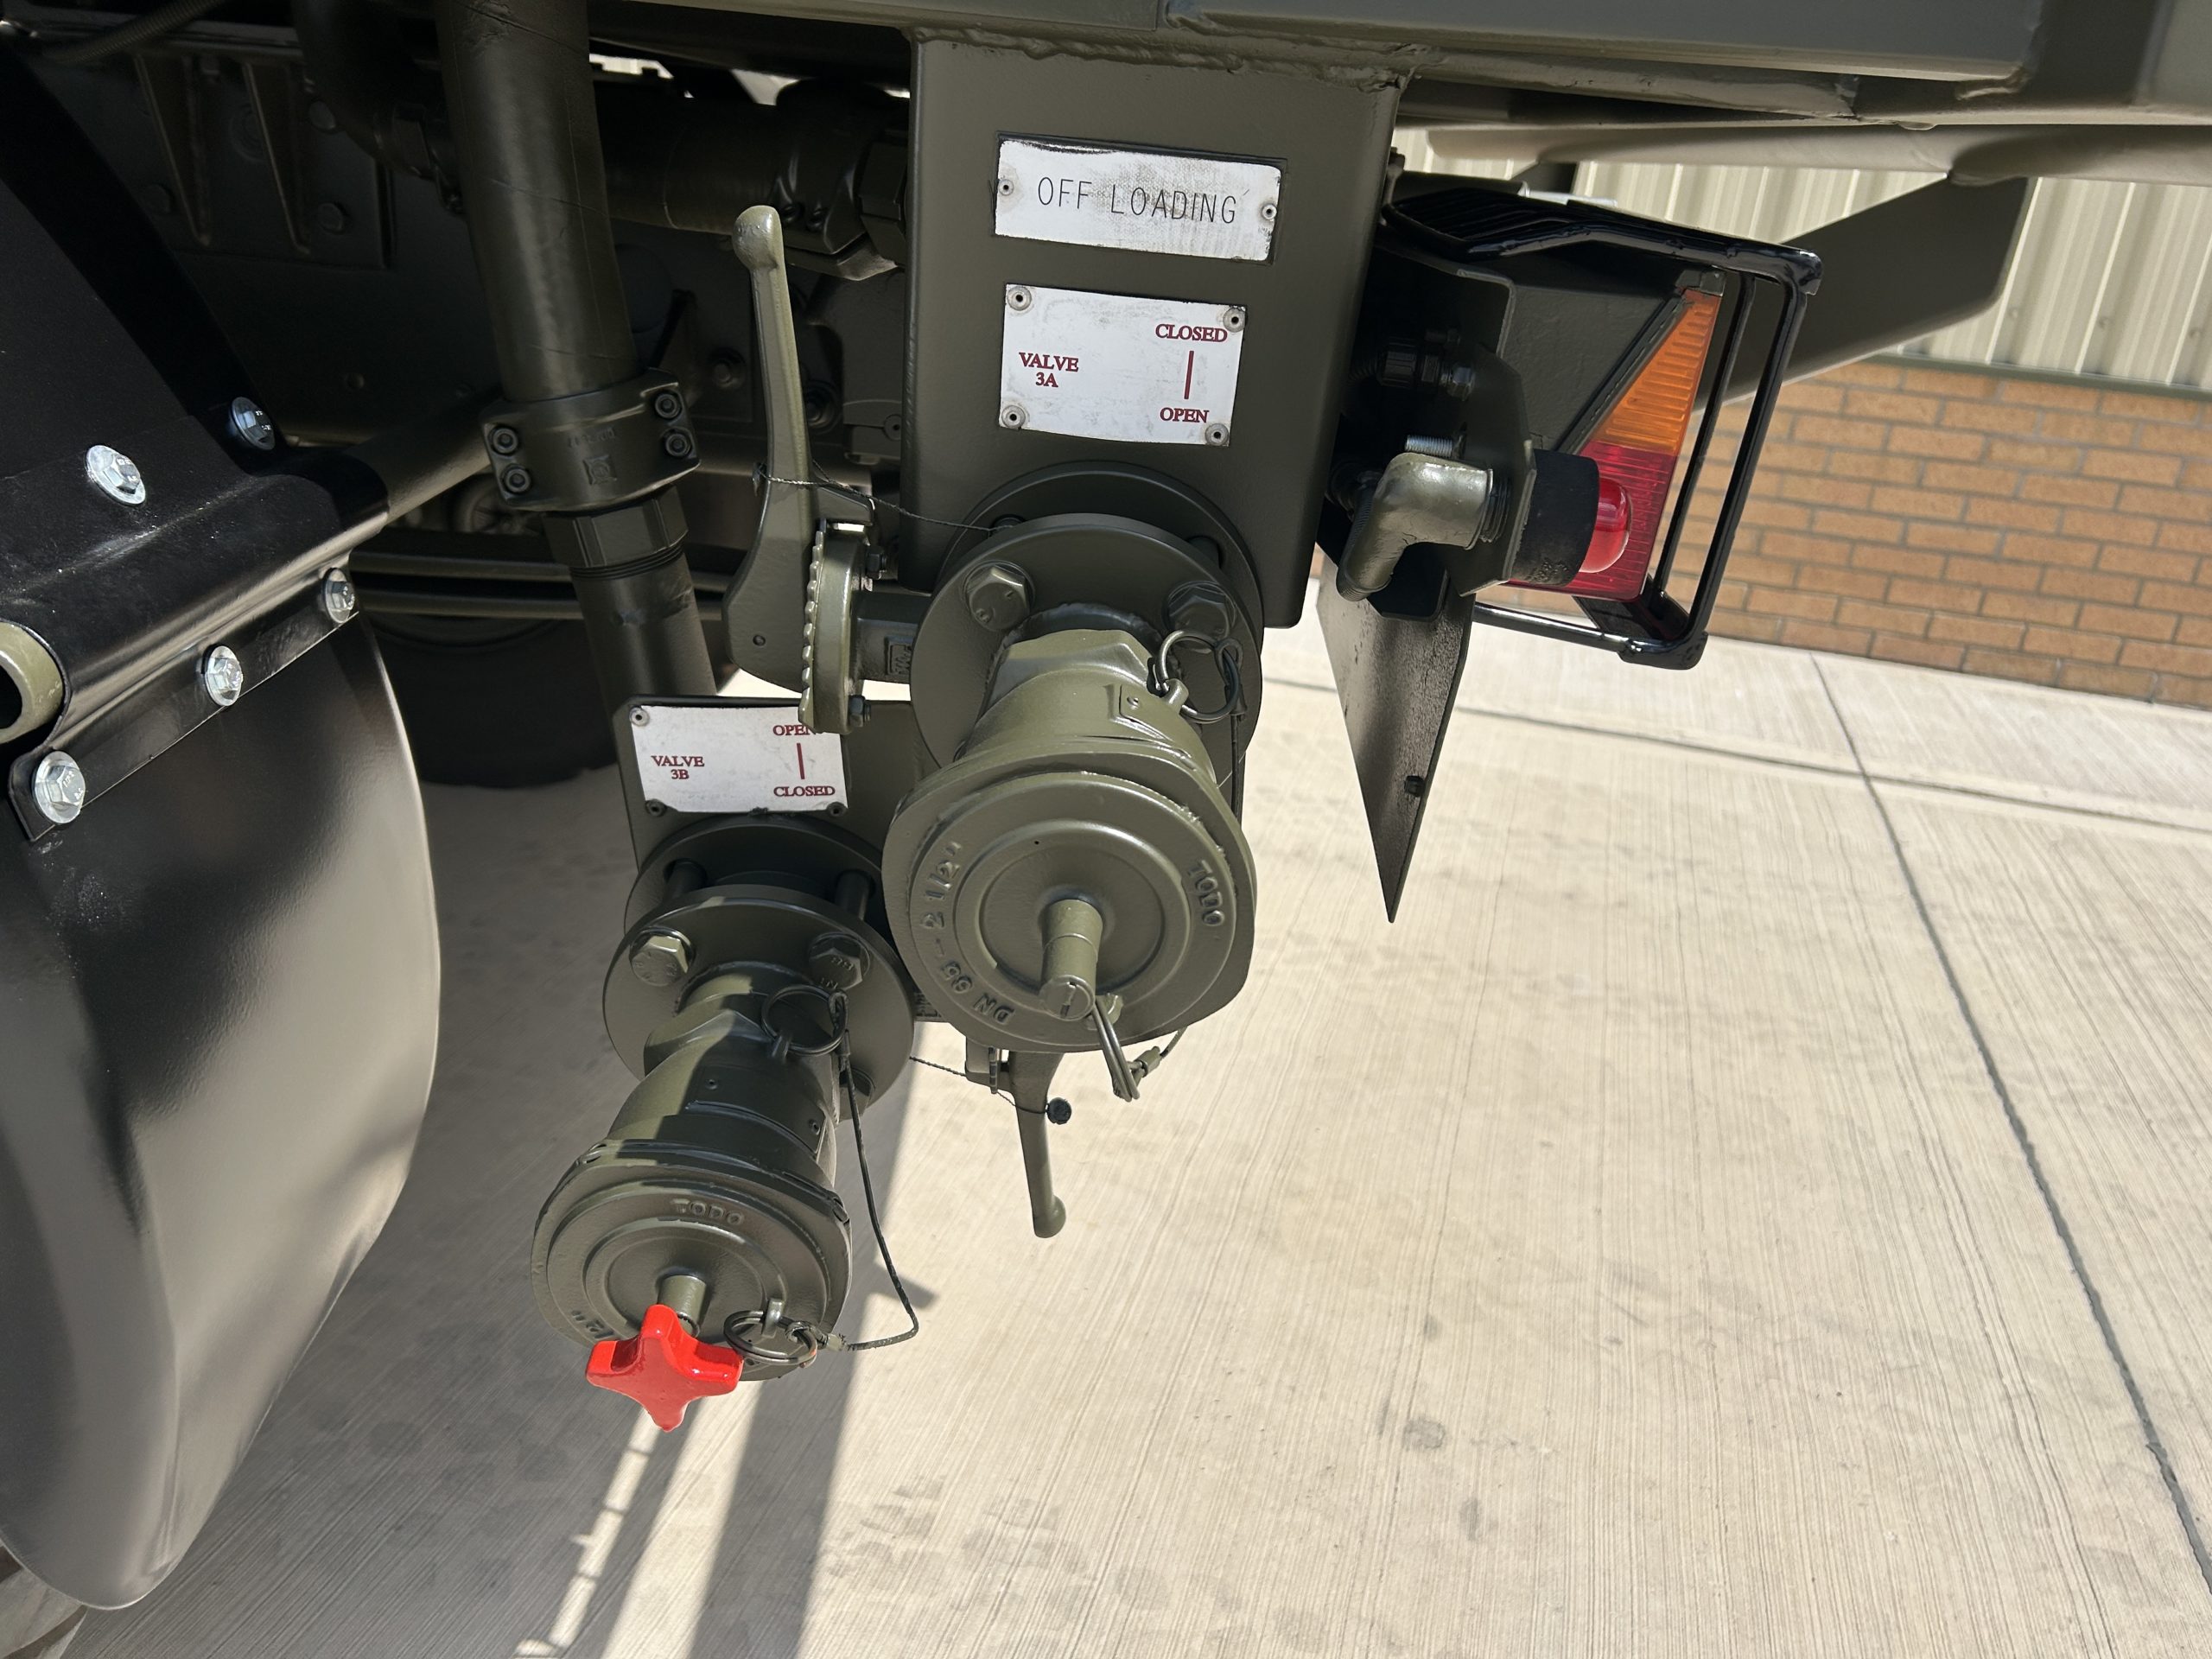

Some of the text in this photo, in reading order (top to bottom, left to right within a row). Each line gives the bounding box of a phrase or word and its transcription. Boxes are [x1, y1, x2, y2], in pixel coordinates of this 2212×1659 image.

[1037, 176, 1237, 225] OFF LOADING
[1154, 323, 1228, 342] CLOSED
[1019, 352, 1079, 372] VALVE
[1035, 372, 1058, 388] 3A
[1160, 407, 1210, 423] OPEN
[651, 755, 705, 767] VALVE
[671, 769, 690, 779] 3B
[773, 785, 836, 797] CLOSED
[1187, 858, 1226, 927] TODO
[671, 1198, 746, 1225] TODO
